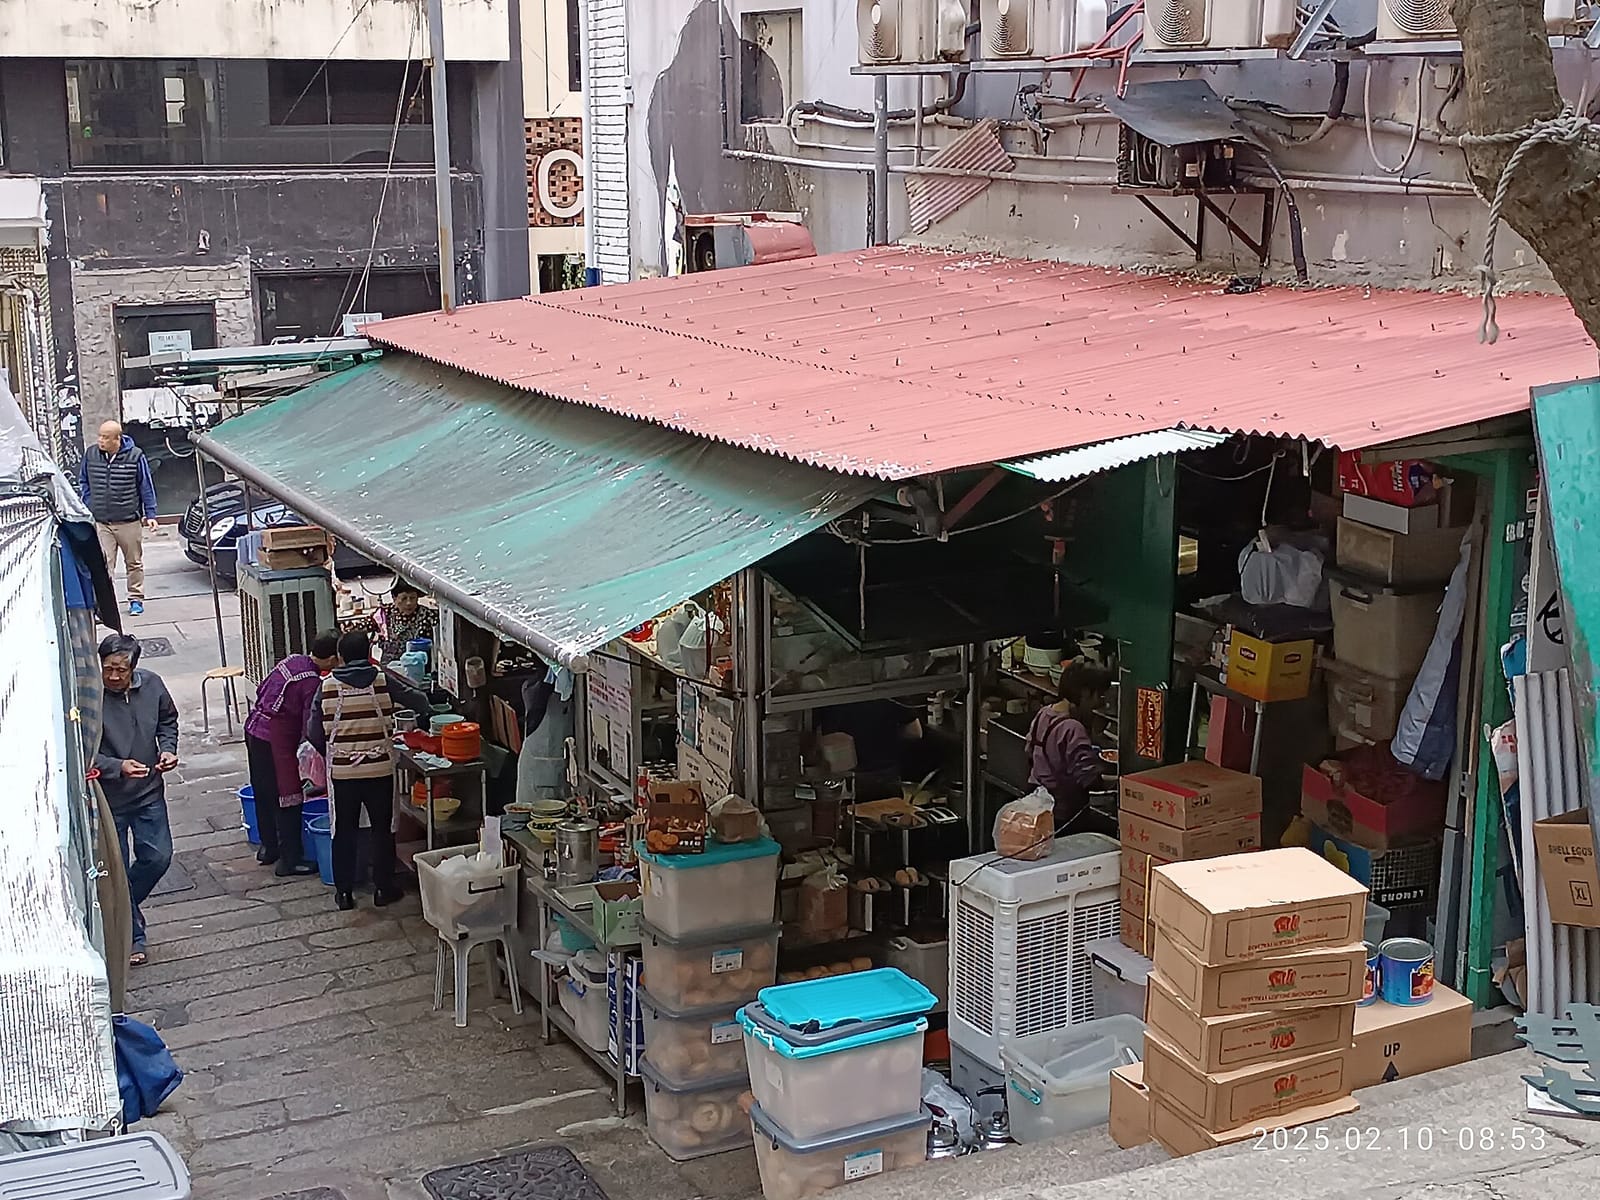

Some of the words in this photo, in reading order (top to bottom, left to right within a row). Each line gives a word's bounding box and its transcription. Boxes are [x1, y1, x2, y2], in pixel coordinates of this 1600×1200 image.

[1571, 846, 1593, 856] EGGS
[1574, 886, 1588, 900] XL
[1384, 1042, 1400, 1057] UP
